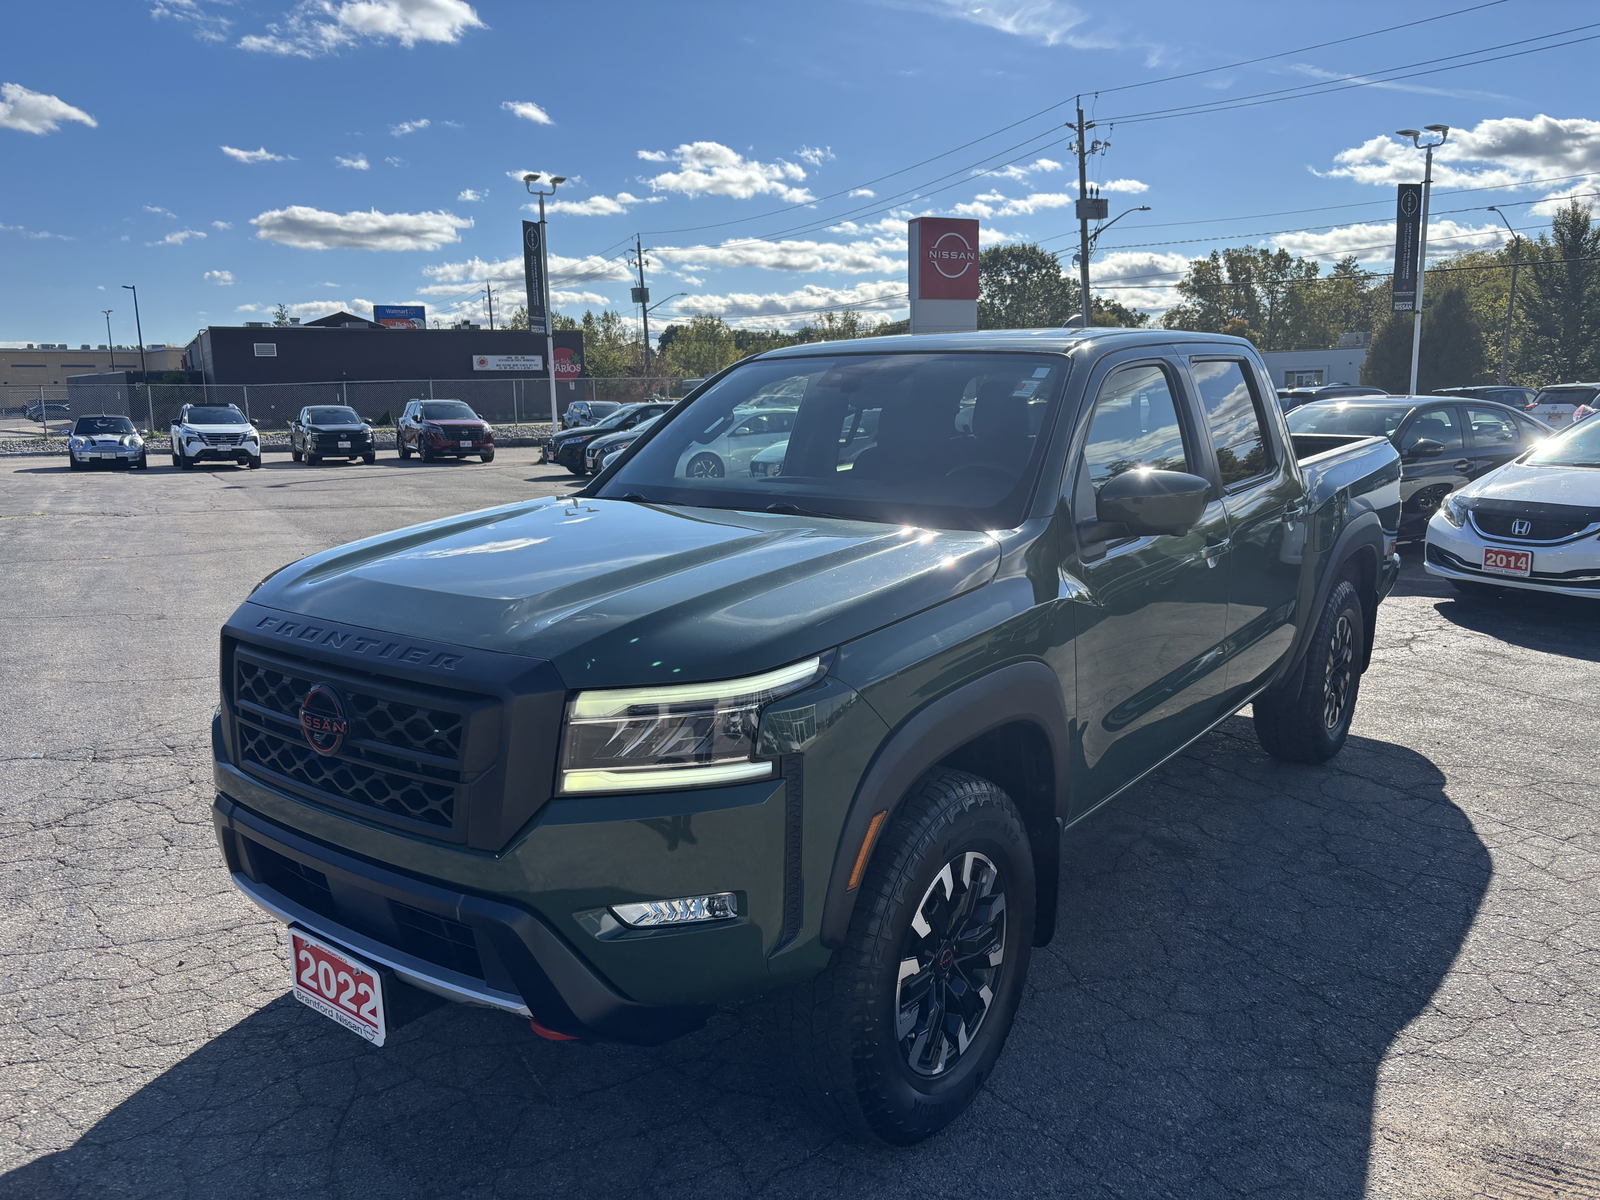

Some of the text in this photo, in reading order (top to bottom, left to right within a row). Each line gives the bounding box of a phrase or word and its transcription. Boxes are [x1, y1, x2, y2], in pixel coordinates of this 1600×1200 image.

[929, 250, 974, 260] NISSAN
[547, 363, 581, 373] ARIOS
[1485, 552, 1527, 570] 2014
[255, 616, 465, 671] FRONTIER
[303, 712, 346, 733] SSAN
[298, 949, 379, 1018] 2022
[296, 990, 363, 1035] Brantford Nissan
